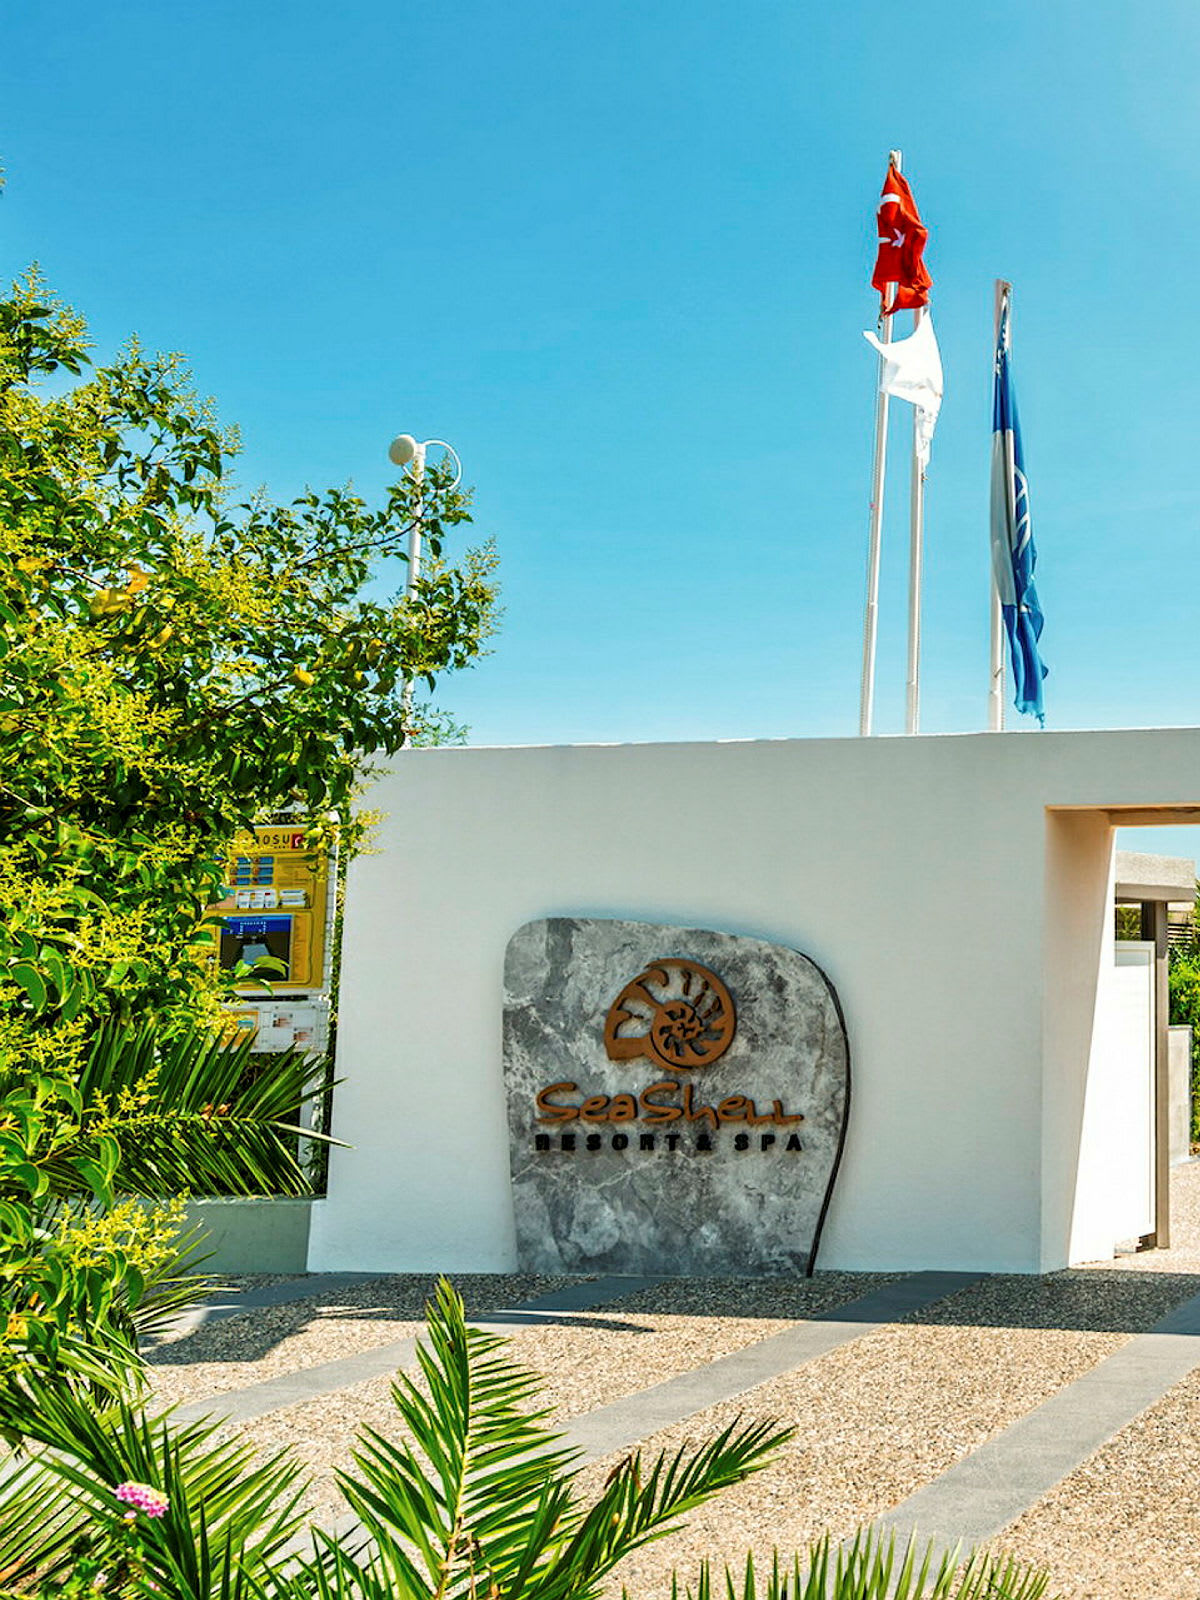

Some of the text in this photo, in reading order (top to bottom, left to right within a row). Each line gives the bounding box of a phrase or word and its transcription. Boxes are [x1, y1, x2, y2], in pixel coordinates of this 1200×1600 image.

[535, 1133, 803, 1151] RESORT & SPA
